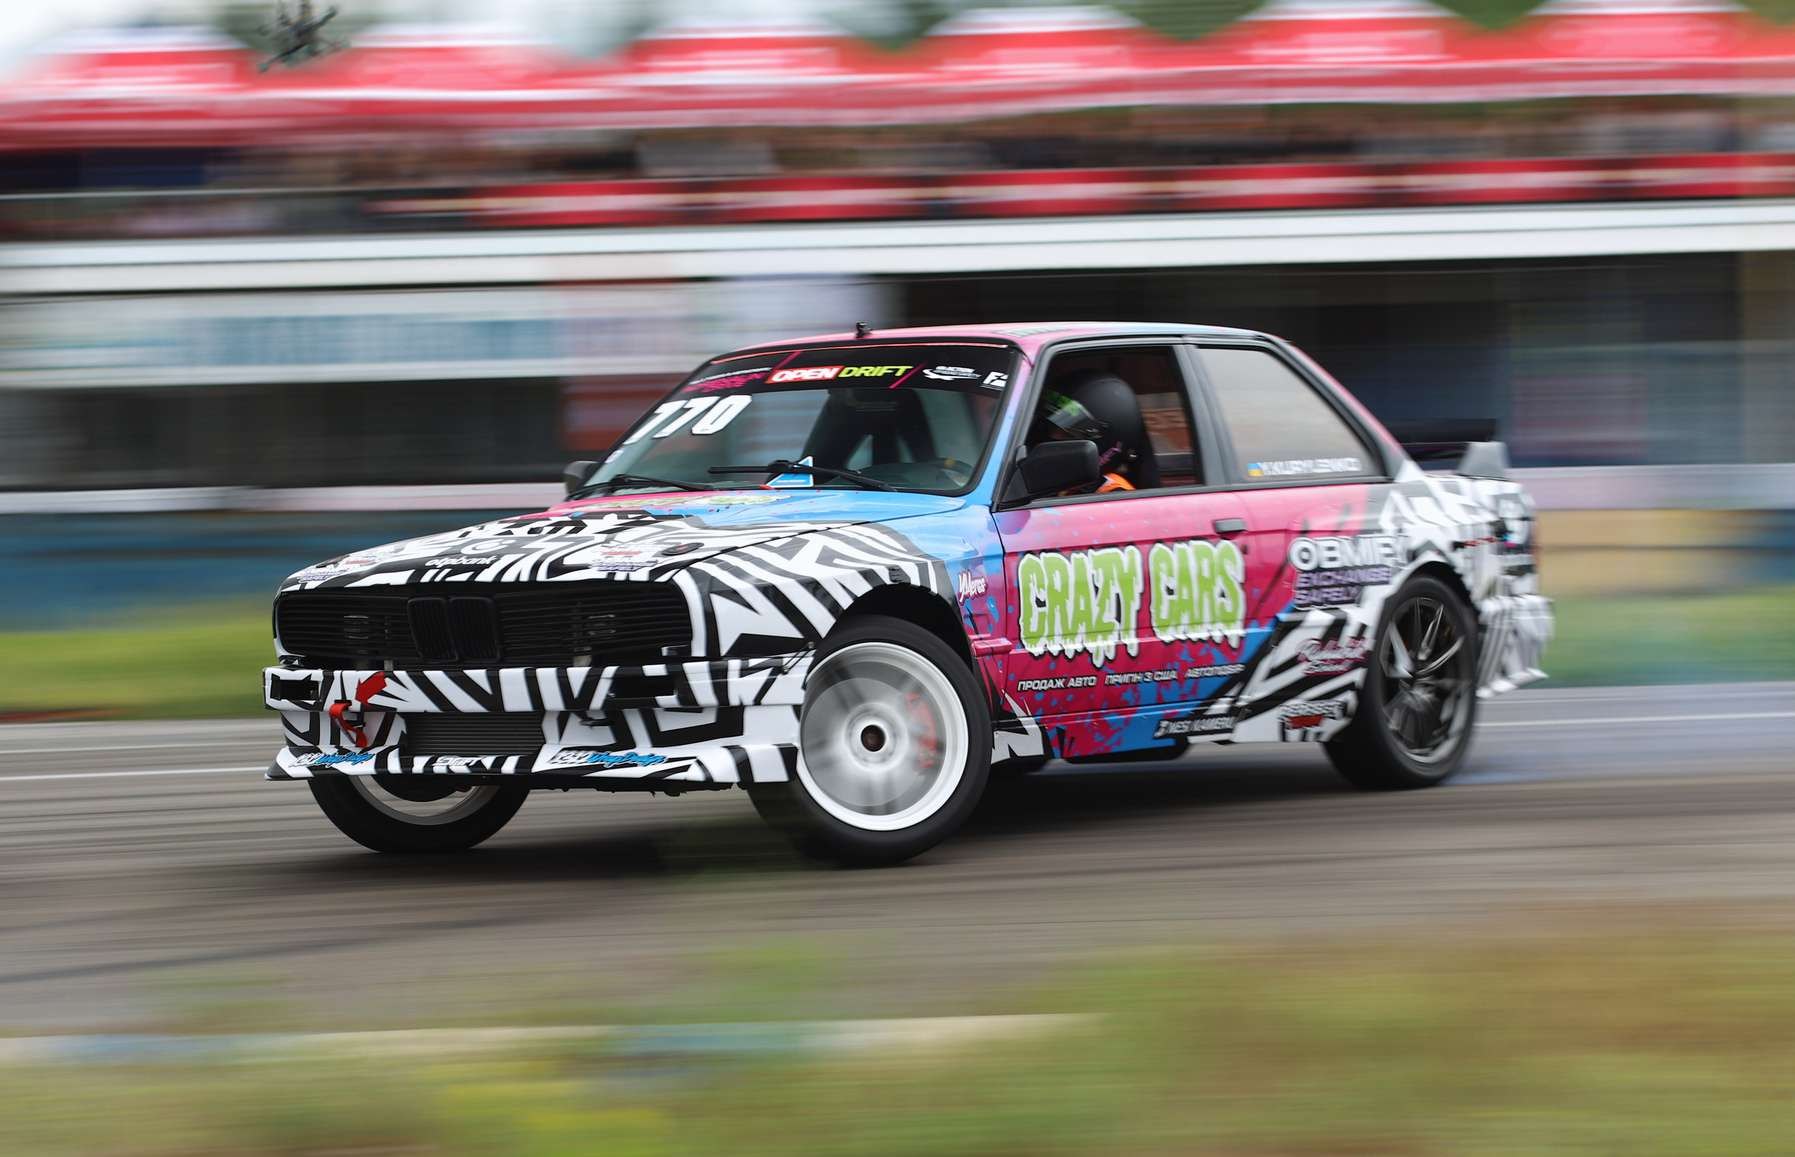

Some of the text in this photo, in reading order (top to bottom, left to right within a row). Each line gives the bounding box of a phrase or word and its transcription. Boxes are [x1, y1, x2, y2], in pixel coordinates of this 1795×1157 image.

[772, 367, 840, 382] OPEN
[838, 366, 913, 378] DRIFT
[1018, 540, 1246, 668] CRAZY CARS
[1017, 676, 1097, 691] ПРОДАЖ АВТО
